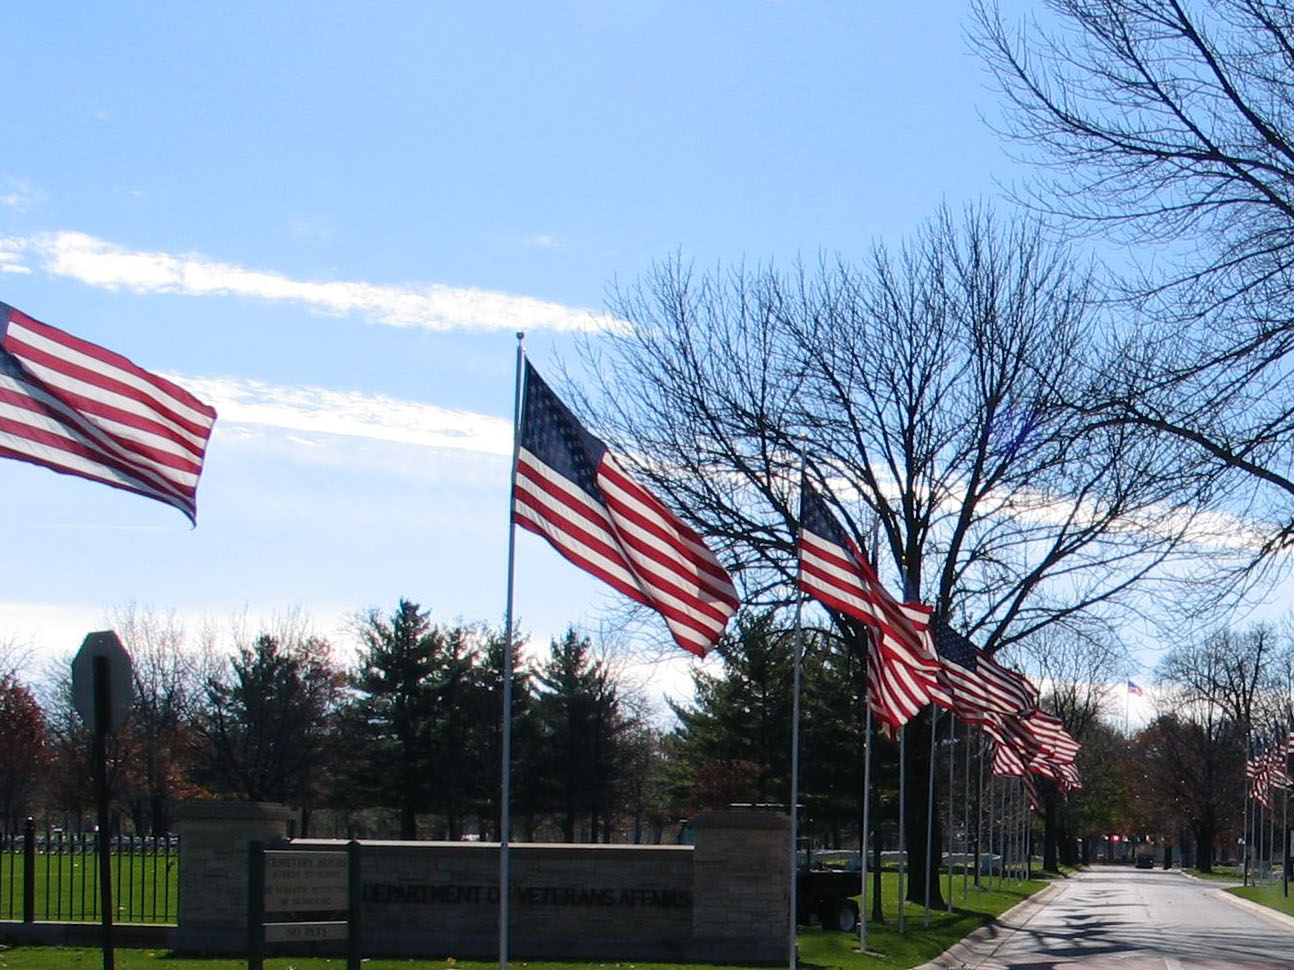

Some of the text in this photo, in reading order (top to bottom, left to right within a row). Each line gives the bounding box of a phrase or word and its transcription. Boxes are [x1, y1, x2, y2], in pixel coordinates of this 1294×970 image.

[362, 883, 484, 904] DEPARTMENT
[517, 886, 615, 906] VETERANS
[619, 887, 692, 908] AFFAIRS
